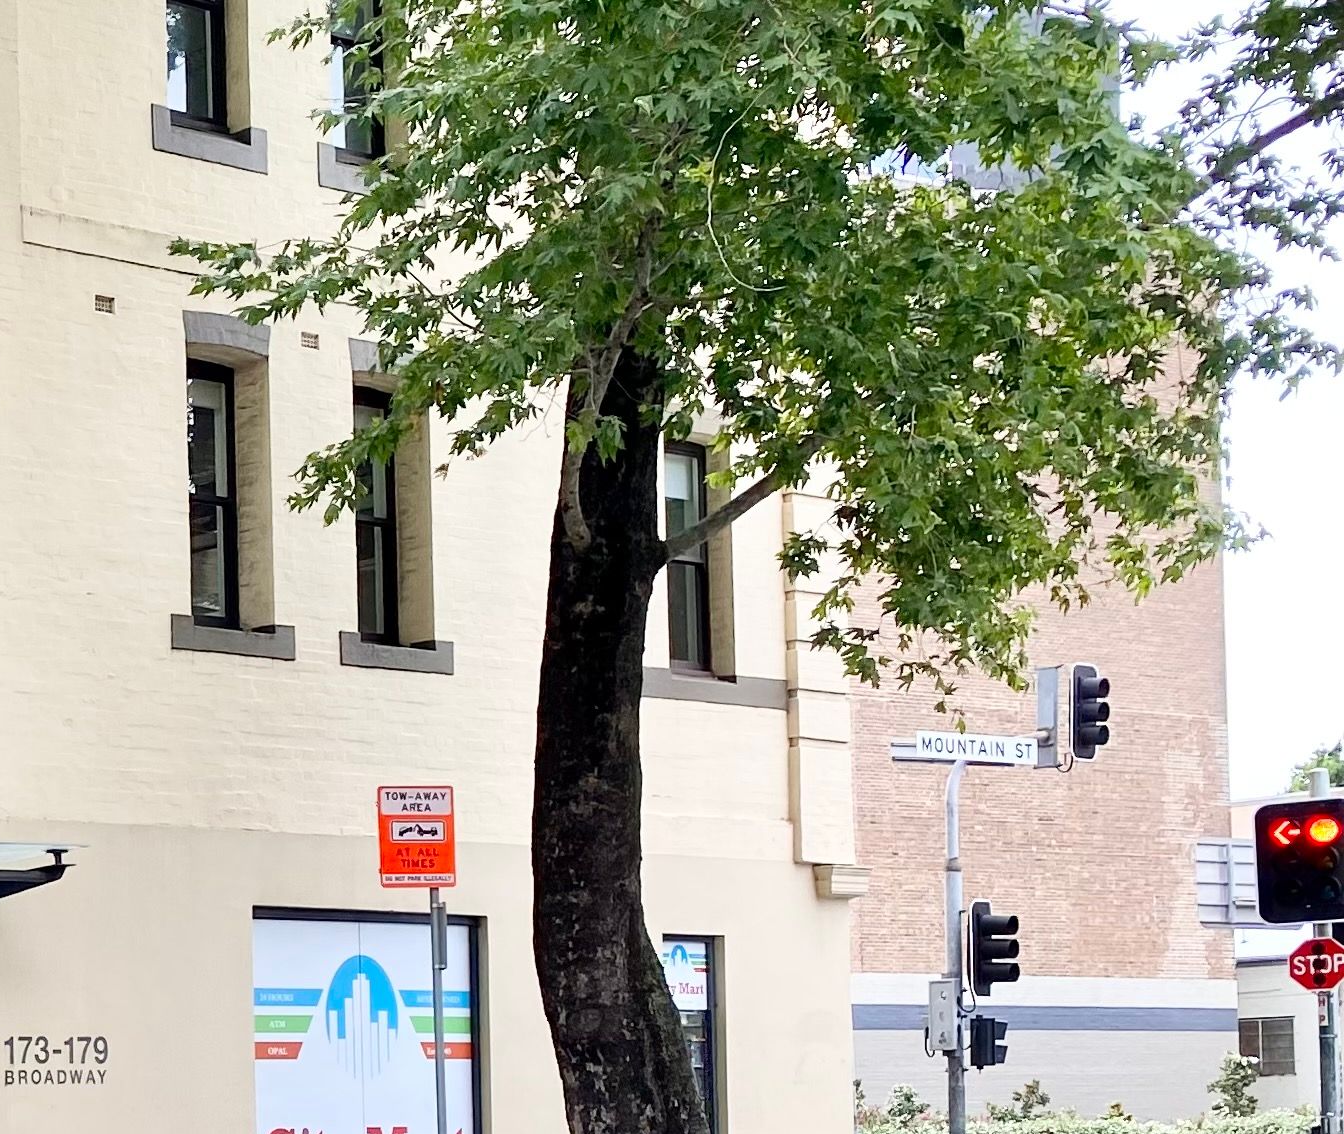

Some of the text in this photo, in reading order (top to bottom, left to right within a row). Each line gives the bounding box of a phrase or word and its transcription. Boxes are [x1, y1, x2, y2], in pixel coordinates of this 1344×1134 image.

[921, 736, 1032, 758] MOUNTAIN ST
[384, 791, 447, 801] TOW-AWAY
[401, 803, 432, 812] AREA
[396, 847, 440, 857] AT ALL
[400, 858, 435, 869] TIMES
[678, 982, 704, 995] Mart
[4, 1036, 108, 1065] 173-179
[4, 1069, 107, 1086] BROADWAY
